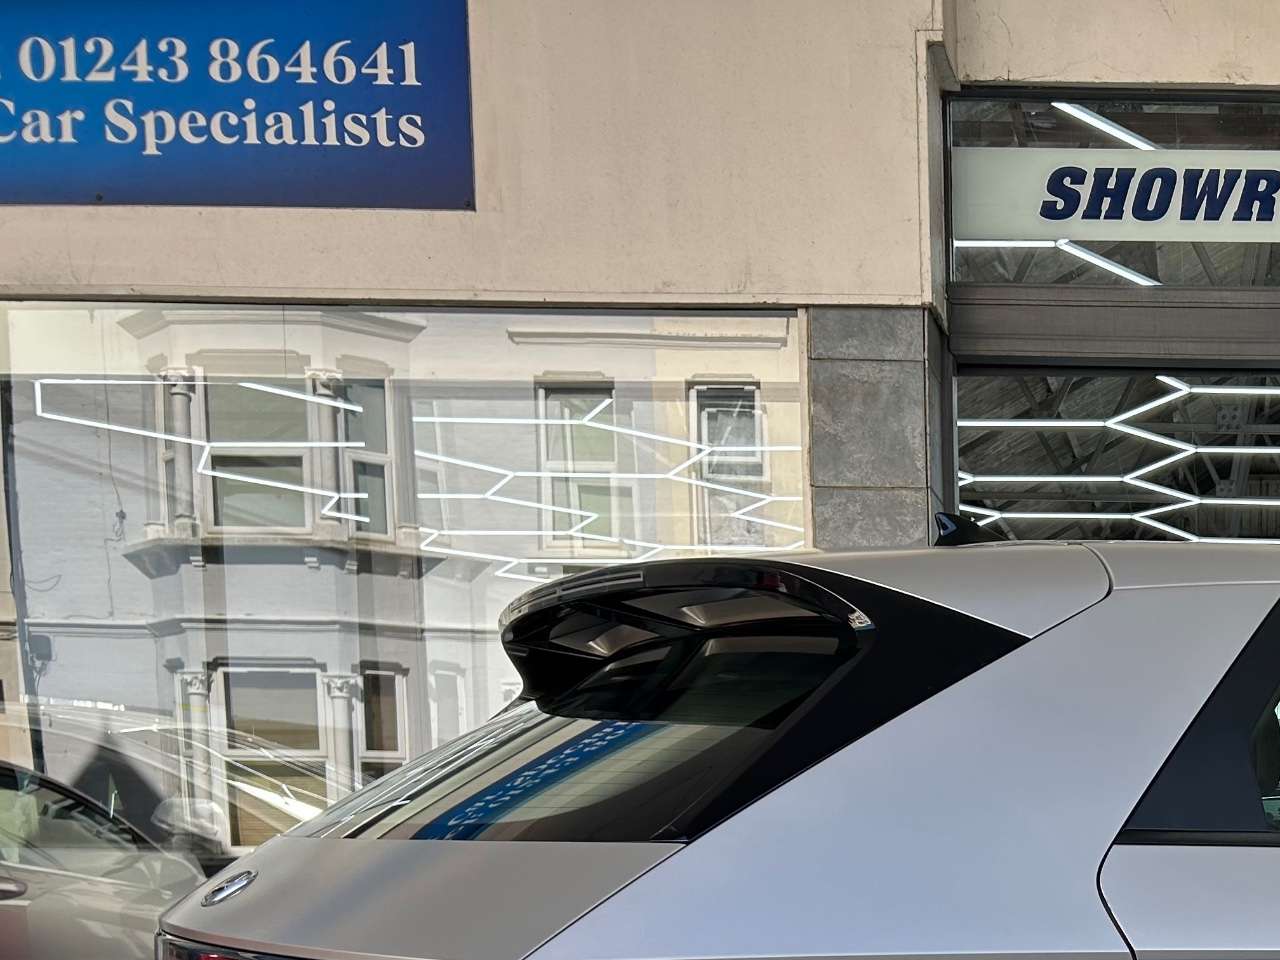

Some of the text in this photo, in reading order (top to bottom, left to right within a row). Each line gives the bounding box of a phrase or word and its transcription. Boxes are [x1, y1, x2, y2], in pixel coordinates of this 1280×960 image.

[18, 36, 422, 86] 01243 864641
[0, 97, 425, 155] Car Specialists
